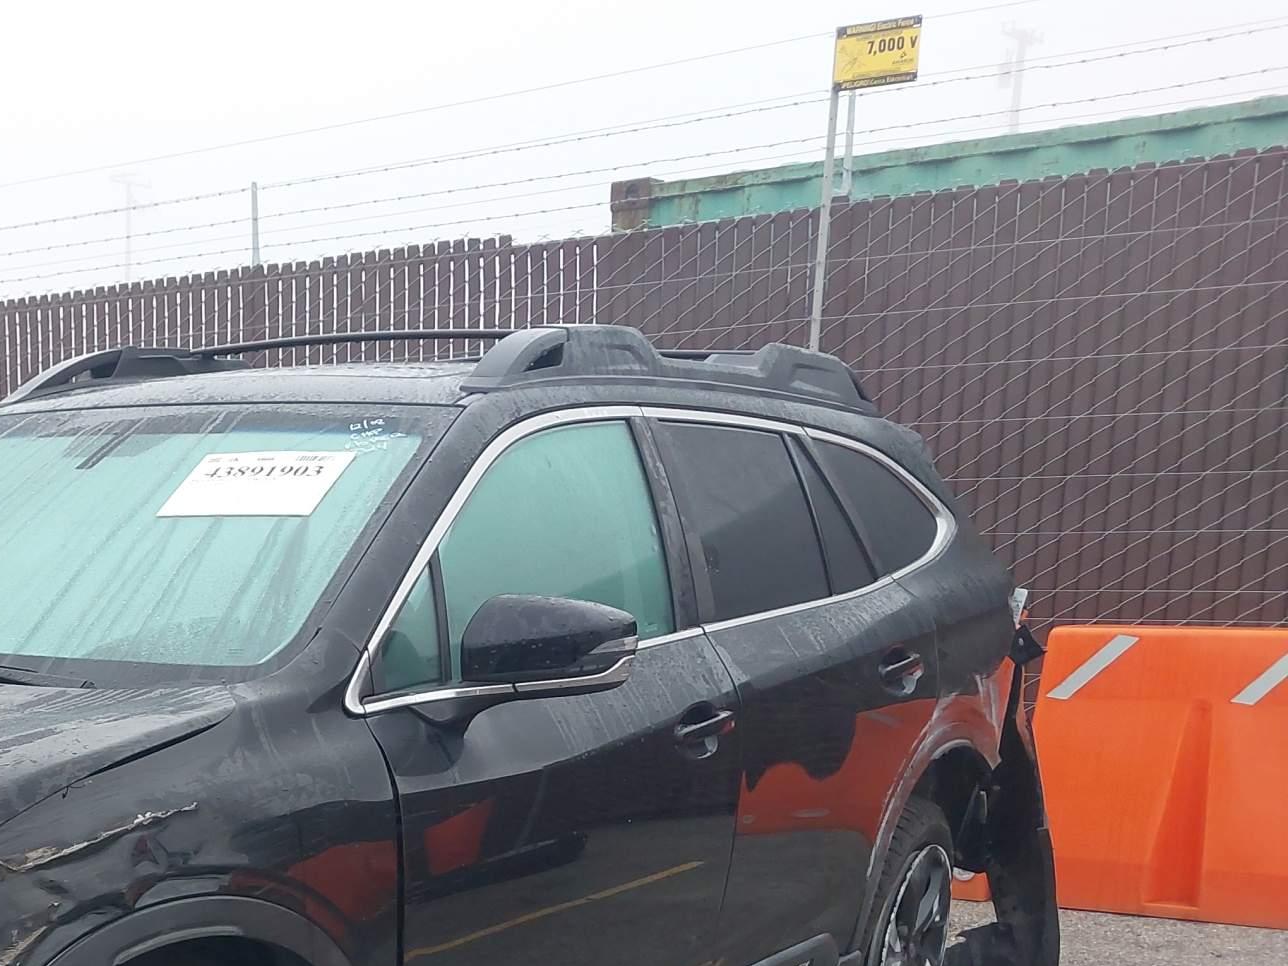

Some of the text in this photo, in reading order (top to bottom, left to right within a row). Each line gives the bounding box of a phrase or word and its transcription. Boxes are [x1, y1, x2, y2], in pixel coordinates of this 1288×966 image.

[867, 36, 905, 56] 7,000
[910, 35, 918, 48] V
[204, 464, 324, 479] 43891903
